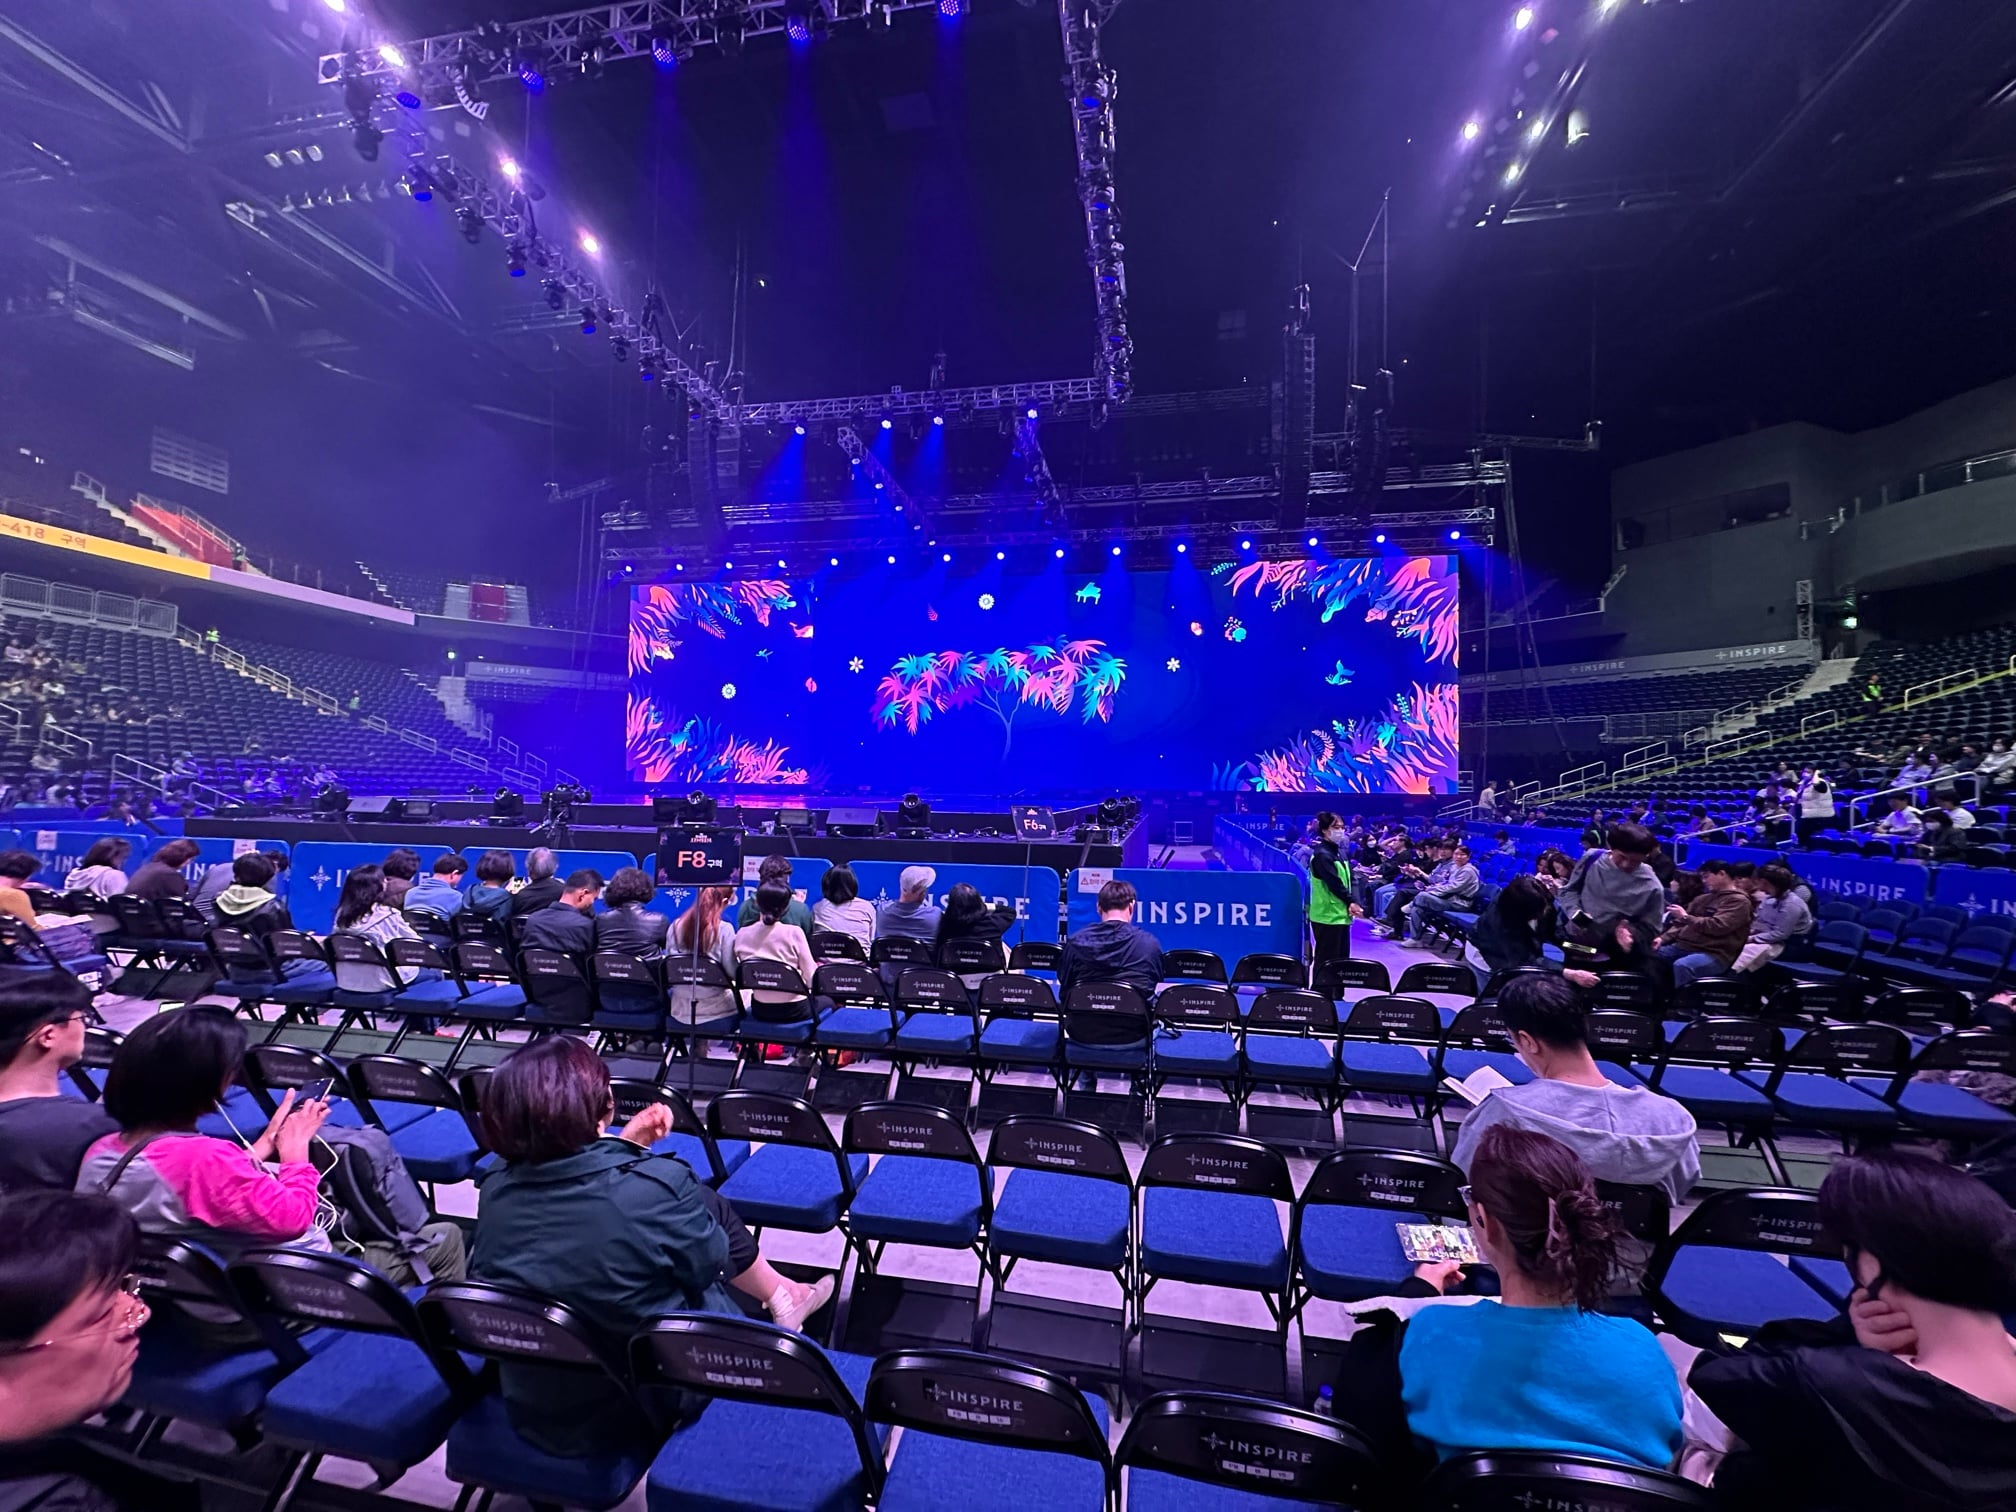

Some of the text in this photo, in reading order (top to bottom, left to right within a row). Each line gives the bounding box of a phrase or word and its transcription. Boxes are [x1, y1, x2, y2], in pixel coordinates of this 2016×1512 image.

[1728, 645, 1787, 660] INSPIRE
[1579, 661, 1625, 674] INSPIRE
[1136, 901, 1272, 926] INSPIRE
[920, 981, 945, 990] INSPIRE
[1007, 987, 1033, 996] INSPIRE
[1095, 993, 1121, 1001] INSPIRE
[1188, 998, 1216, 1007] INSPIRE
[1284, 1004, 1313, 1013] INSPIRE
[1385, 1011, 1415, 1021] INSPIRE
[1604, 1026, 1638, 1036] INSPIRE
[751, 1113, 791, 1125] INSPIRE
[891, 1125, 933, 1136] INSPIRE
[1039, 1141, 1083, 1153] INSPIRE
[1201, 1157, 1249, 1170] INSPIRE
[1374, 1176, 1425, 1190] INSPIRE
[487, 1317, 546, 1338] INSPIRE
[707, 1351, 774, 1371] INSPIRE
[950, 1389, 1024, 1412] INSPIRE
[1229, 1439, 1312, 1465] INSPIRE
